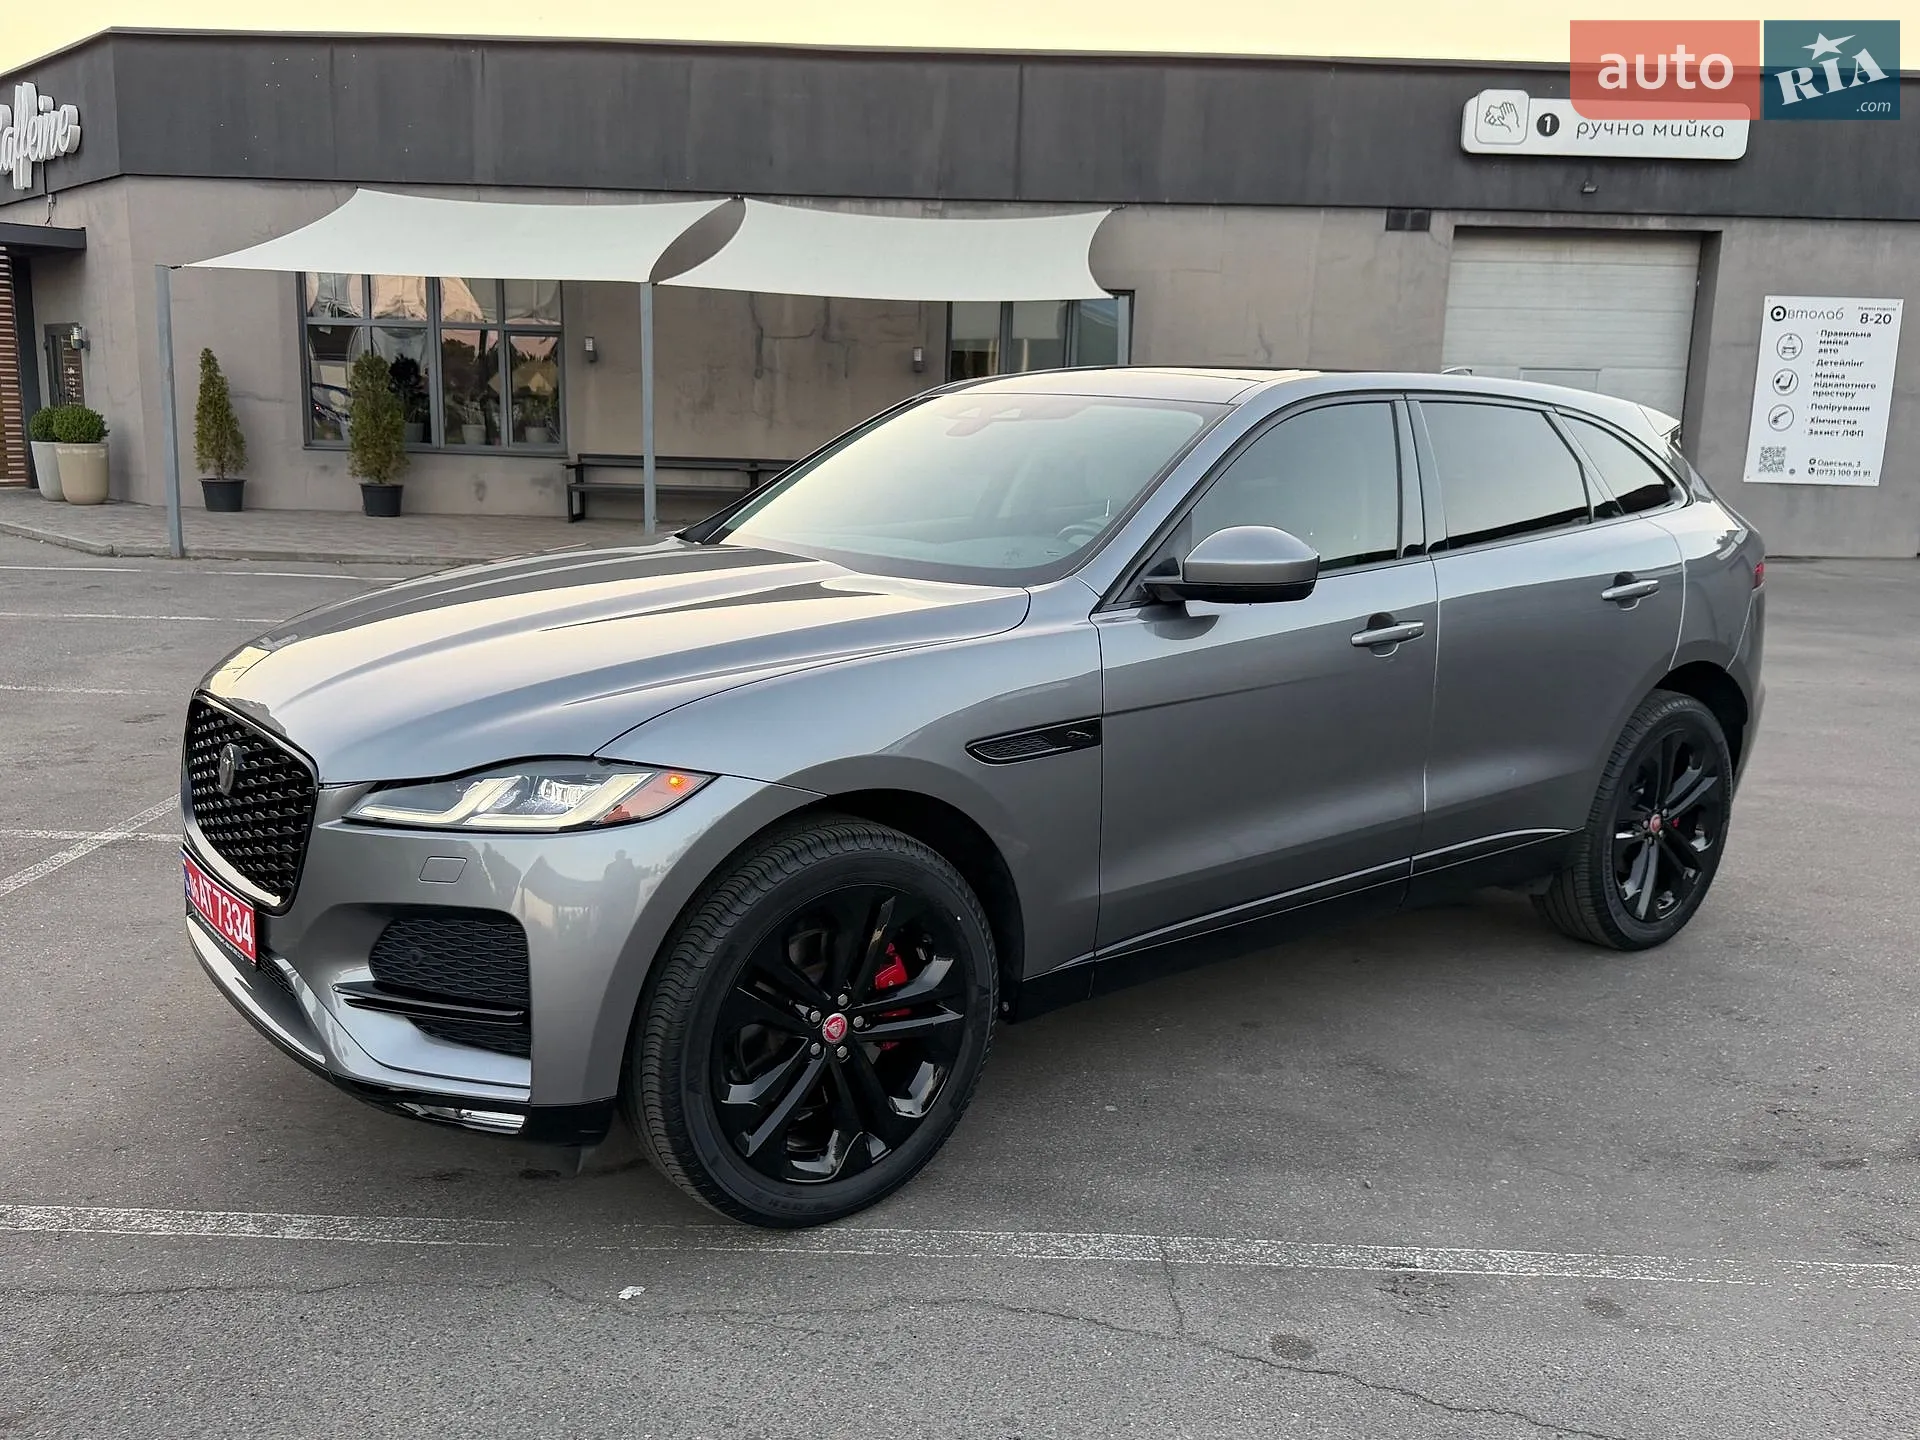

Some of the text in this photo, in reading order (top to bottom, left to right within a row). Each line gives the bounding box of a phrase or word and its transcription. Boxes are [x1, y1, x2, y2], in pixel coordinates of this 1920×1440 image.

[1576, 121, 1645, 140] ручна
[1652, 119, 1725, 138] мийка
[1860, 313, 1892, 325] 8-20
[1820, 329, 1872, 338] Правильна
[1816, 359, 1864, 367] Детейлінг
[1814, 371, 1846, 379] Мийка
[1812, 390, 1856, 398] простору
[213, 889, 253, 952] 7334
